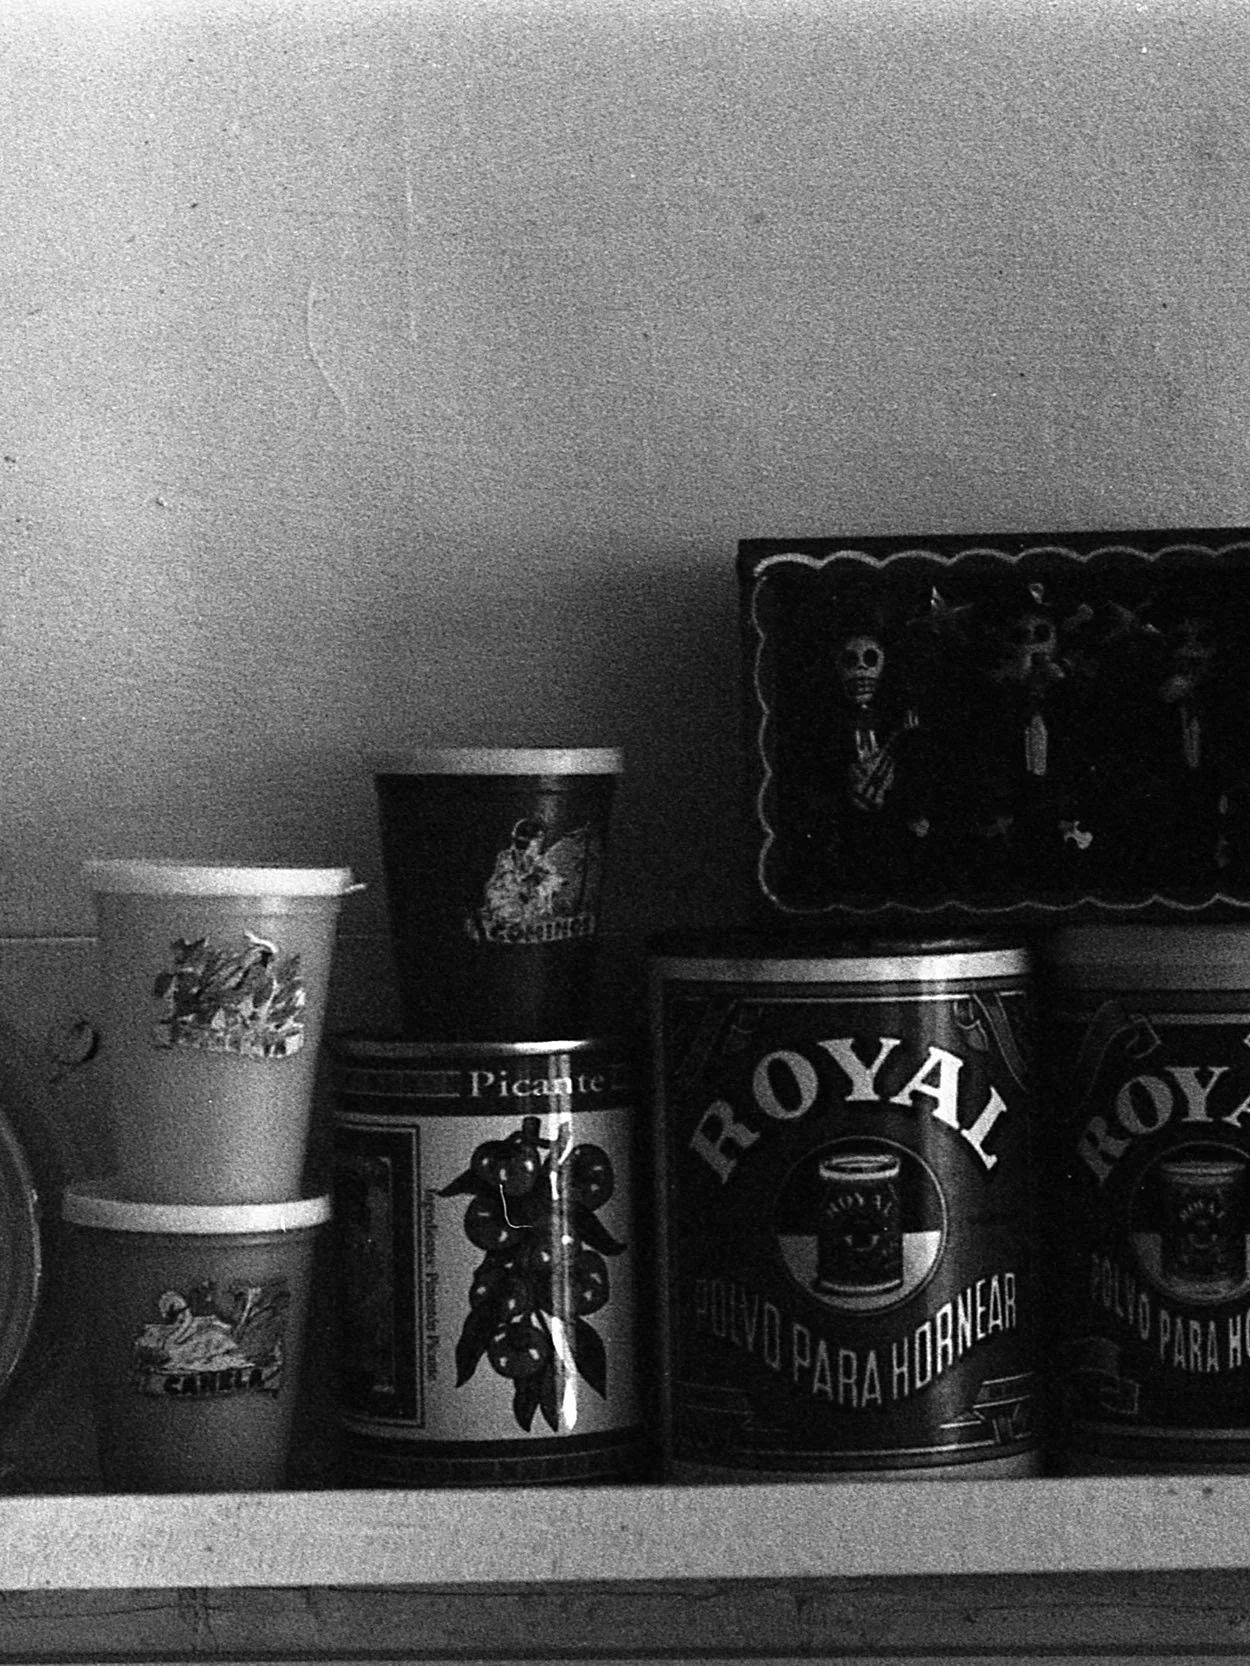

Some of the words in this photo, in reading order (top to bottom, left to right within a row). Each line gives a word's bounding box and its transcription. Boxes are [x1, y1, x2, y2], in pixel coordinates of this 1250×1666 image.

[469, 1070, 606, 1099] Picante
[688, 1036, 1008, 1184] ROYAL
[792, 1322, 883, 1408] PARA
[891, 1271, 1017, 1401] HORNEAR
[1159, 1308, 1220, 1374] PARA
